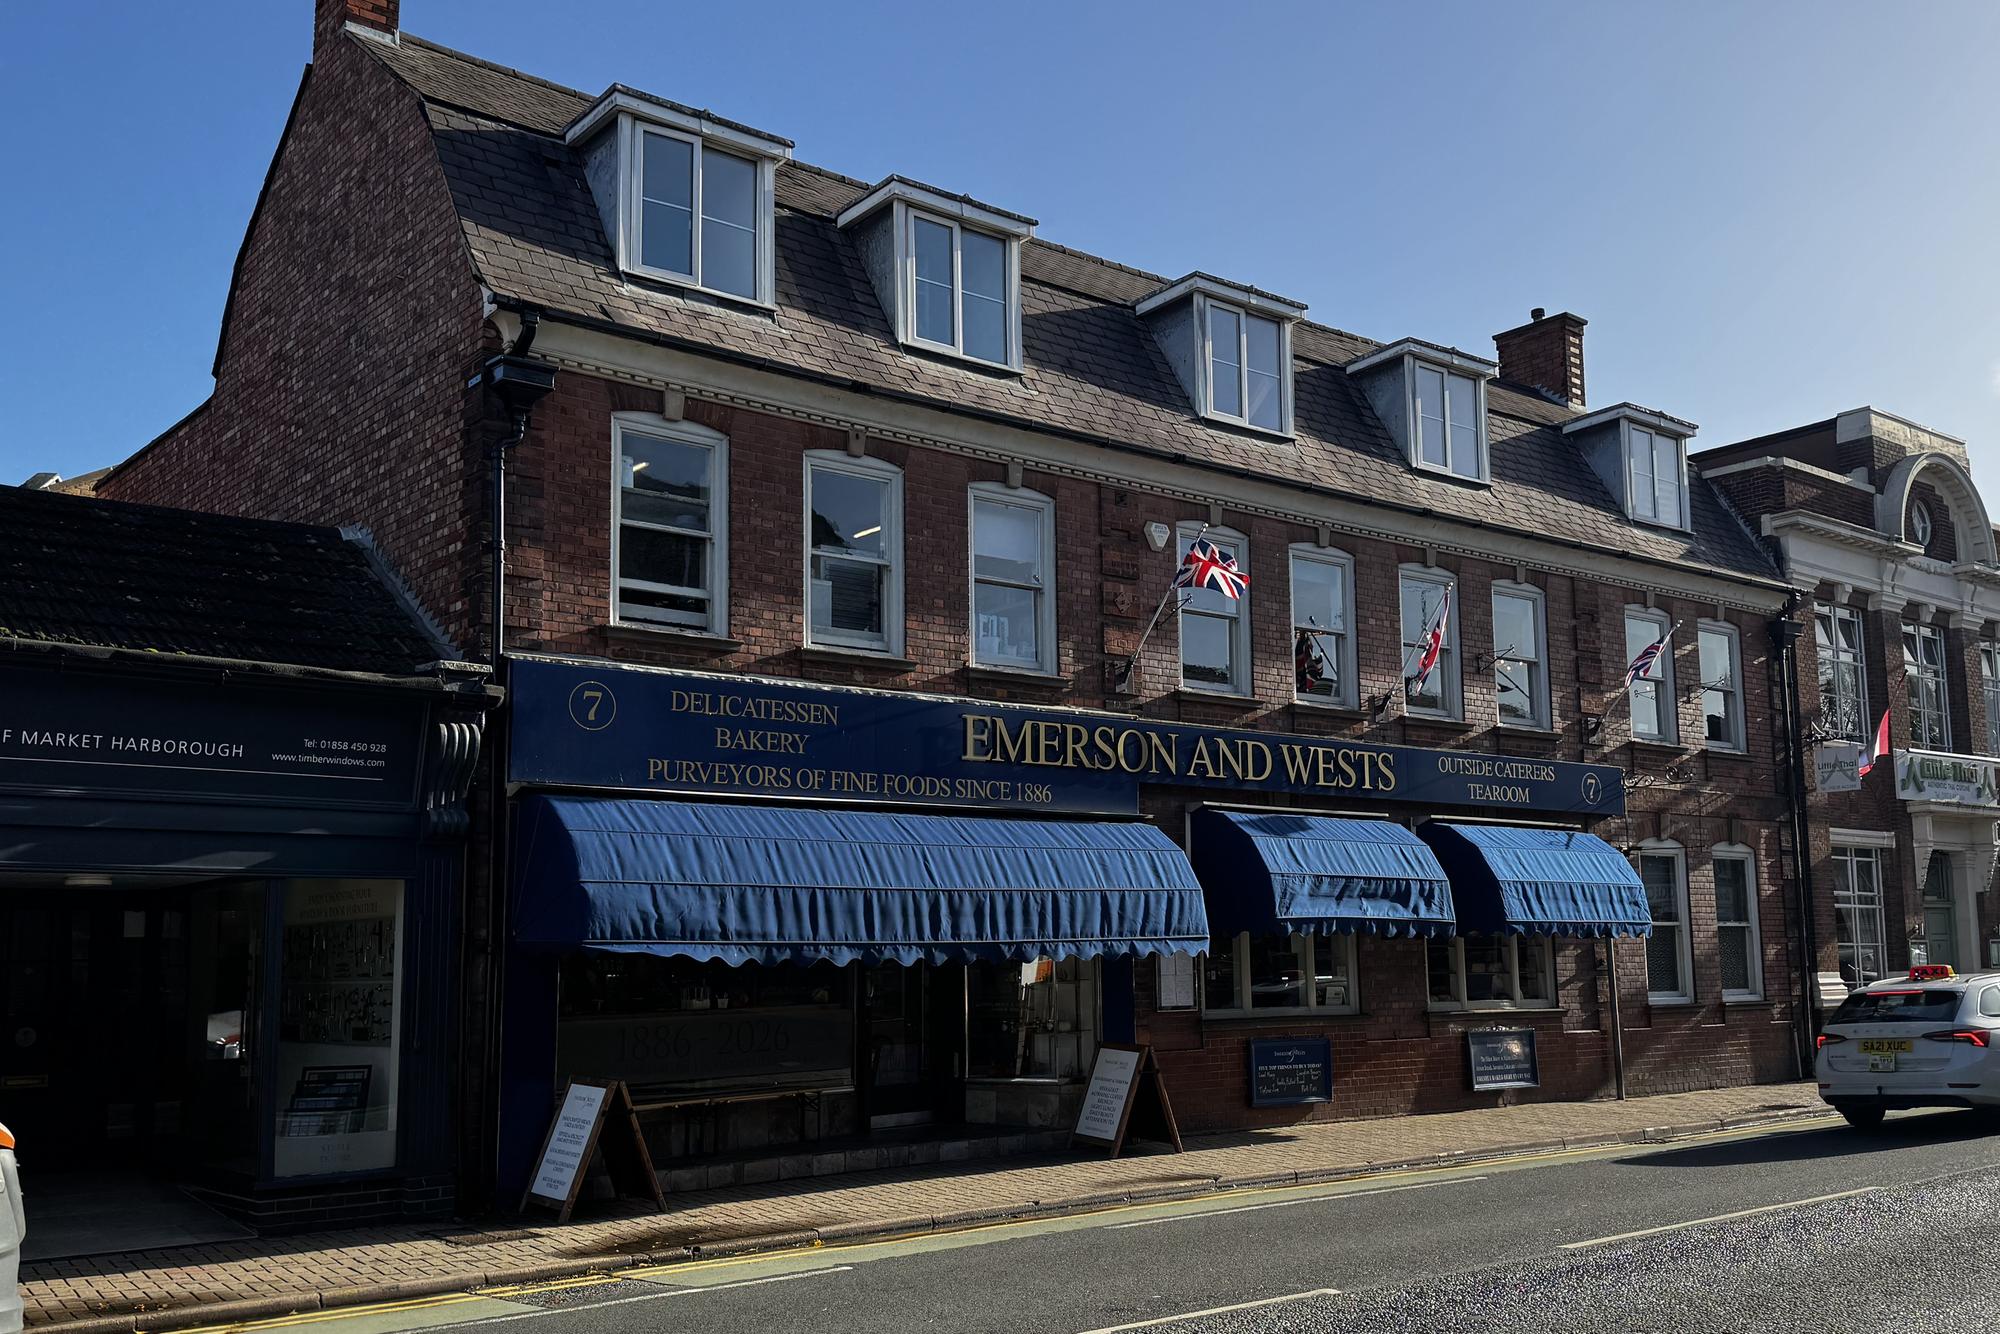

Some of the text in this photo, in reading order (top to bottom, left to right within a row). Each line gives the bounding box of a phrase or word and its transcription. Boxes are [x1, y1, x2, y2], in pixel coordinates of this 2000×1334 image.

[584, 691, 602, 720] 7
[671, 690, 839, 726] DELICATESSEN
[21, 730, 103, 749] MARKET
[111, 736, 244, 758] HARBOROUGH
[304, 738, 387, 753] Tel: 01858 450 928
[715, 727, 811, 754] BAKERY
[961, 714, 1396, 791] EMERSON AND WESTS
[271, 753, 385, 767] www.timberwindows.com
[1438, 756, 1555, 782] OUTSIDE CATERERS
[1840, 760, 1857, 768] Thai
[647, 758, 1052, 804] PURVEYORS OF FINE FOODS SINCE 1886
[1467, 783, 1530, 803] TEAROOM
[1587, 779, 1596, 799] 7
[617, 1024, 690, 1062] 1886
[718, 1019, 790, 1054] 2026
[1863, 1041, 1906, 1051] SA21 XUC
